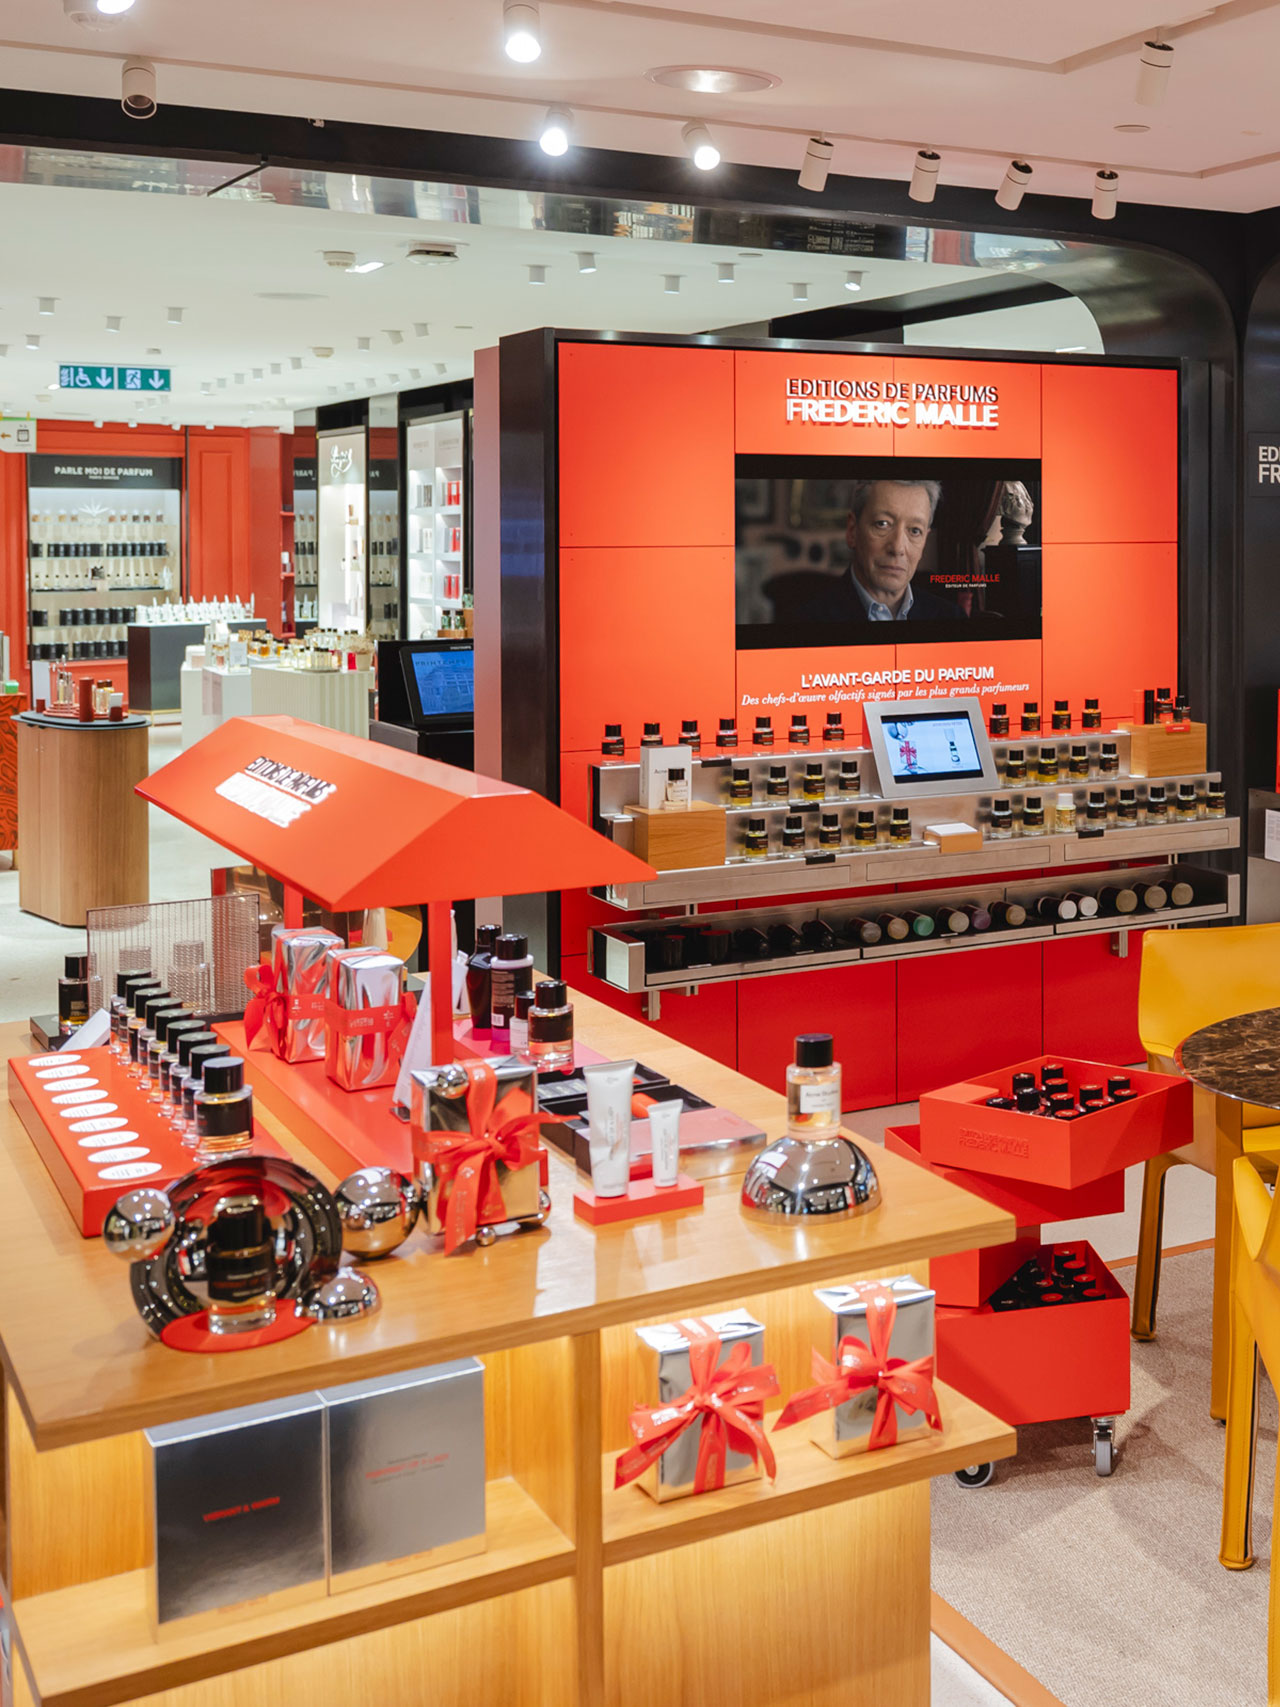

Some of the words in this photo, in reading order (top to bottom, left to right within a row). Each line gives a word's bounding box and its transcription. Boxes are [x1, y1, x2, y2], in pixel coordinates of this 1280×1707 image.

[786, 378, 879, 399] EDITIONS
[882, 382, 909, 400] DE
[912, 383, 999, 404] PARFUMS
[786, 398, 910, 425] FREDERIC
[915, 403, 999, 427] MALLE
[54, 466, 83, 475] PARLE
[84, 467, 102, 475] MOI
[117, 468, 153, 476] PARFUM
[930, 574, 970, 583] FREDERIC
[971, 573, 1000, 583] MALLE
[801, 670, 911, 688] L'AVANT-GARDE
[914, 669, 934, 683] DU
[938, 666, 995, 681] PARFUM
[742, 694, 759, 706] Des
[762, 691, 826, 706] chefs-d'œuvre
[828, 689, 866, 704] olfactifs
[867, 688, 895, 701] signés
[897, 688, 914, 700] par
[915, 686, 927, 696] les
[928, 685, 947, 698] plus
[949, 683, 980, 697] grands
[981, 682, 1030, 696] parfumeurs
